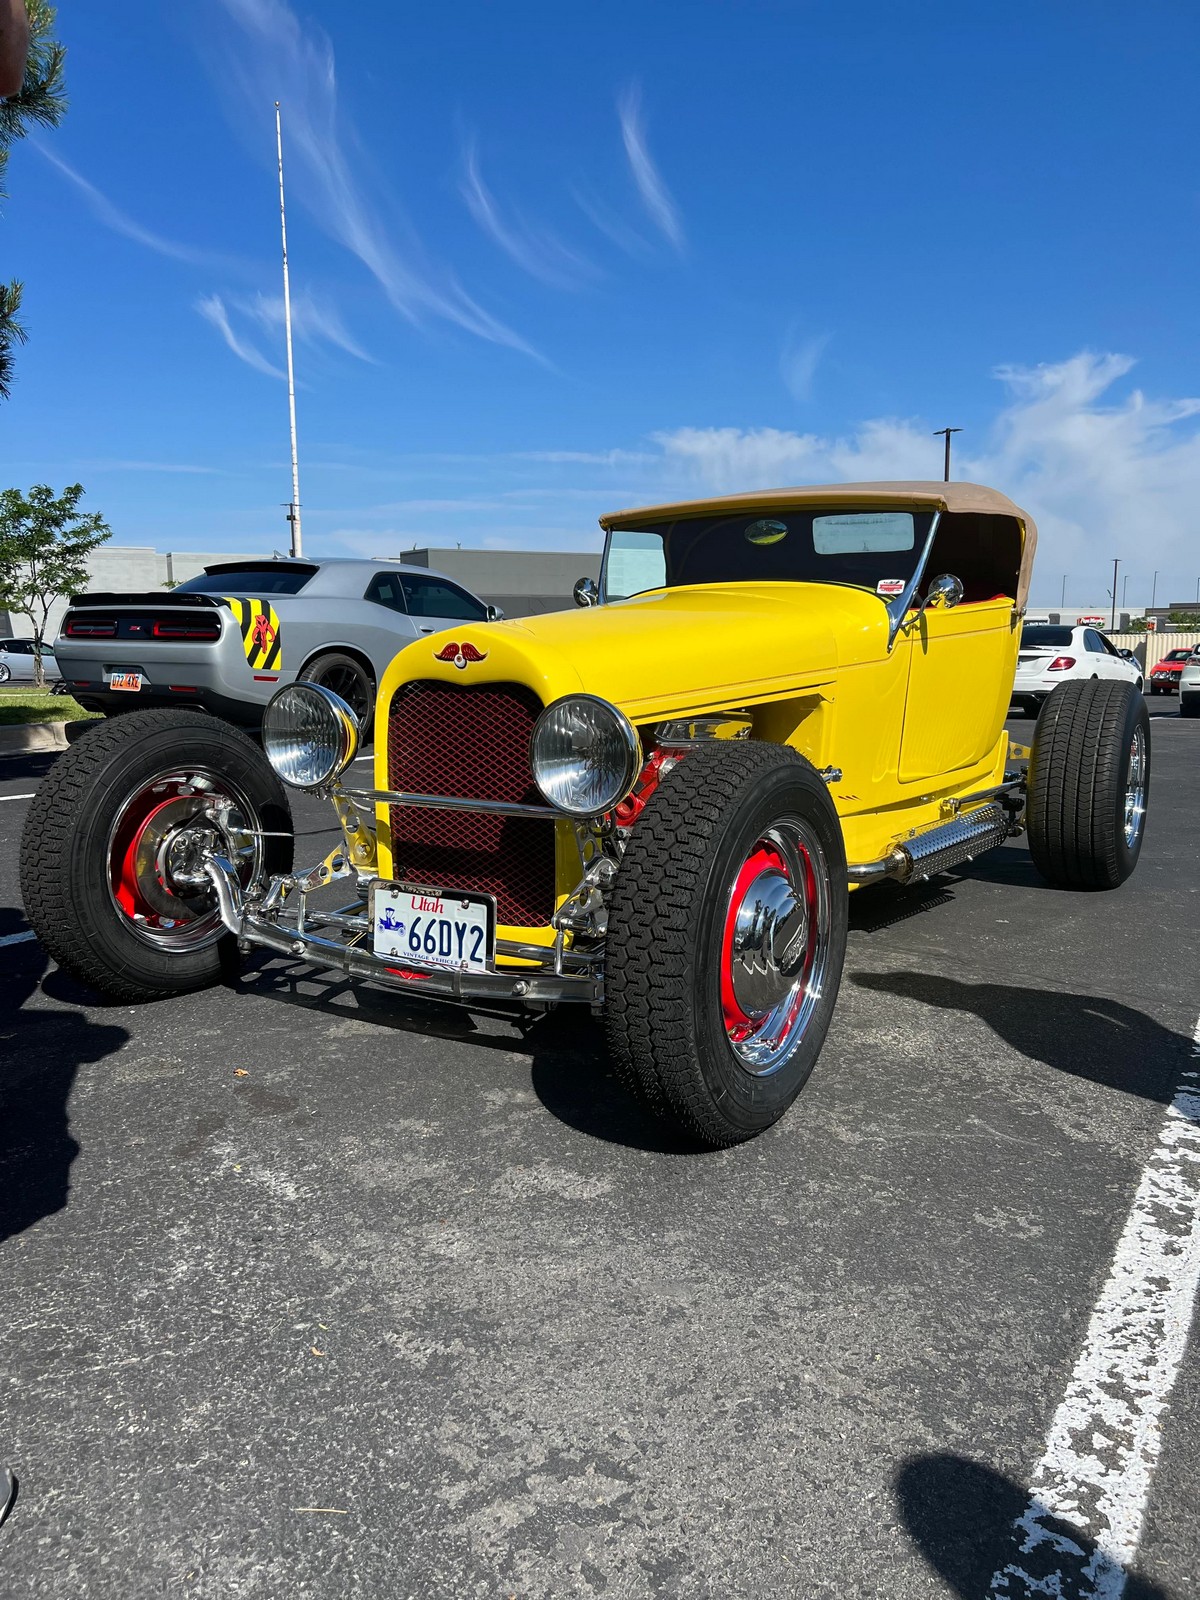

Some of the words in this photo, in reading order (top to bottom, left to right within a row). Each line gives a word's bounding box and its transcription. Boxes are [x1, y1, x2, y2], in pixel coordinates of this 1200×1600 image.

[411, 896, 444, 913] Utah
[408, 916, 484, 963] 66DY2
[403, 951, 429, 960] VINTAGE
[431, 956, 459, 965] VEHICLE
